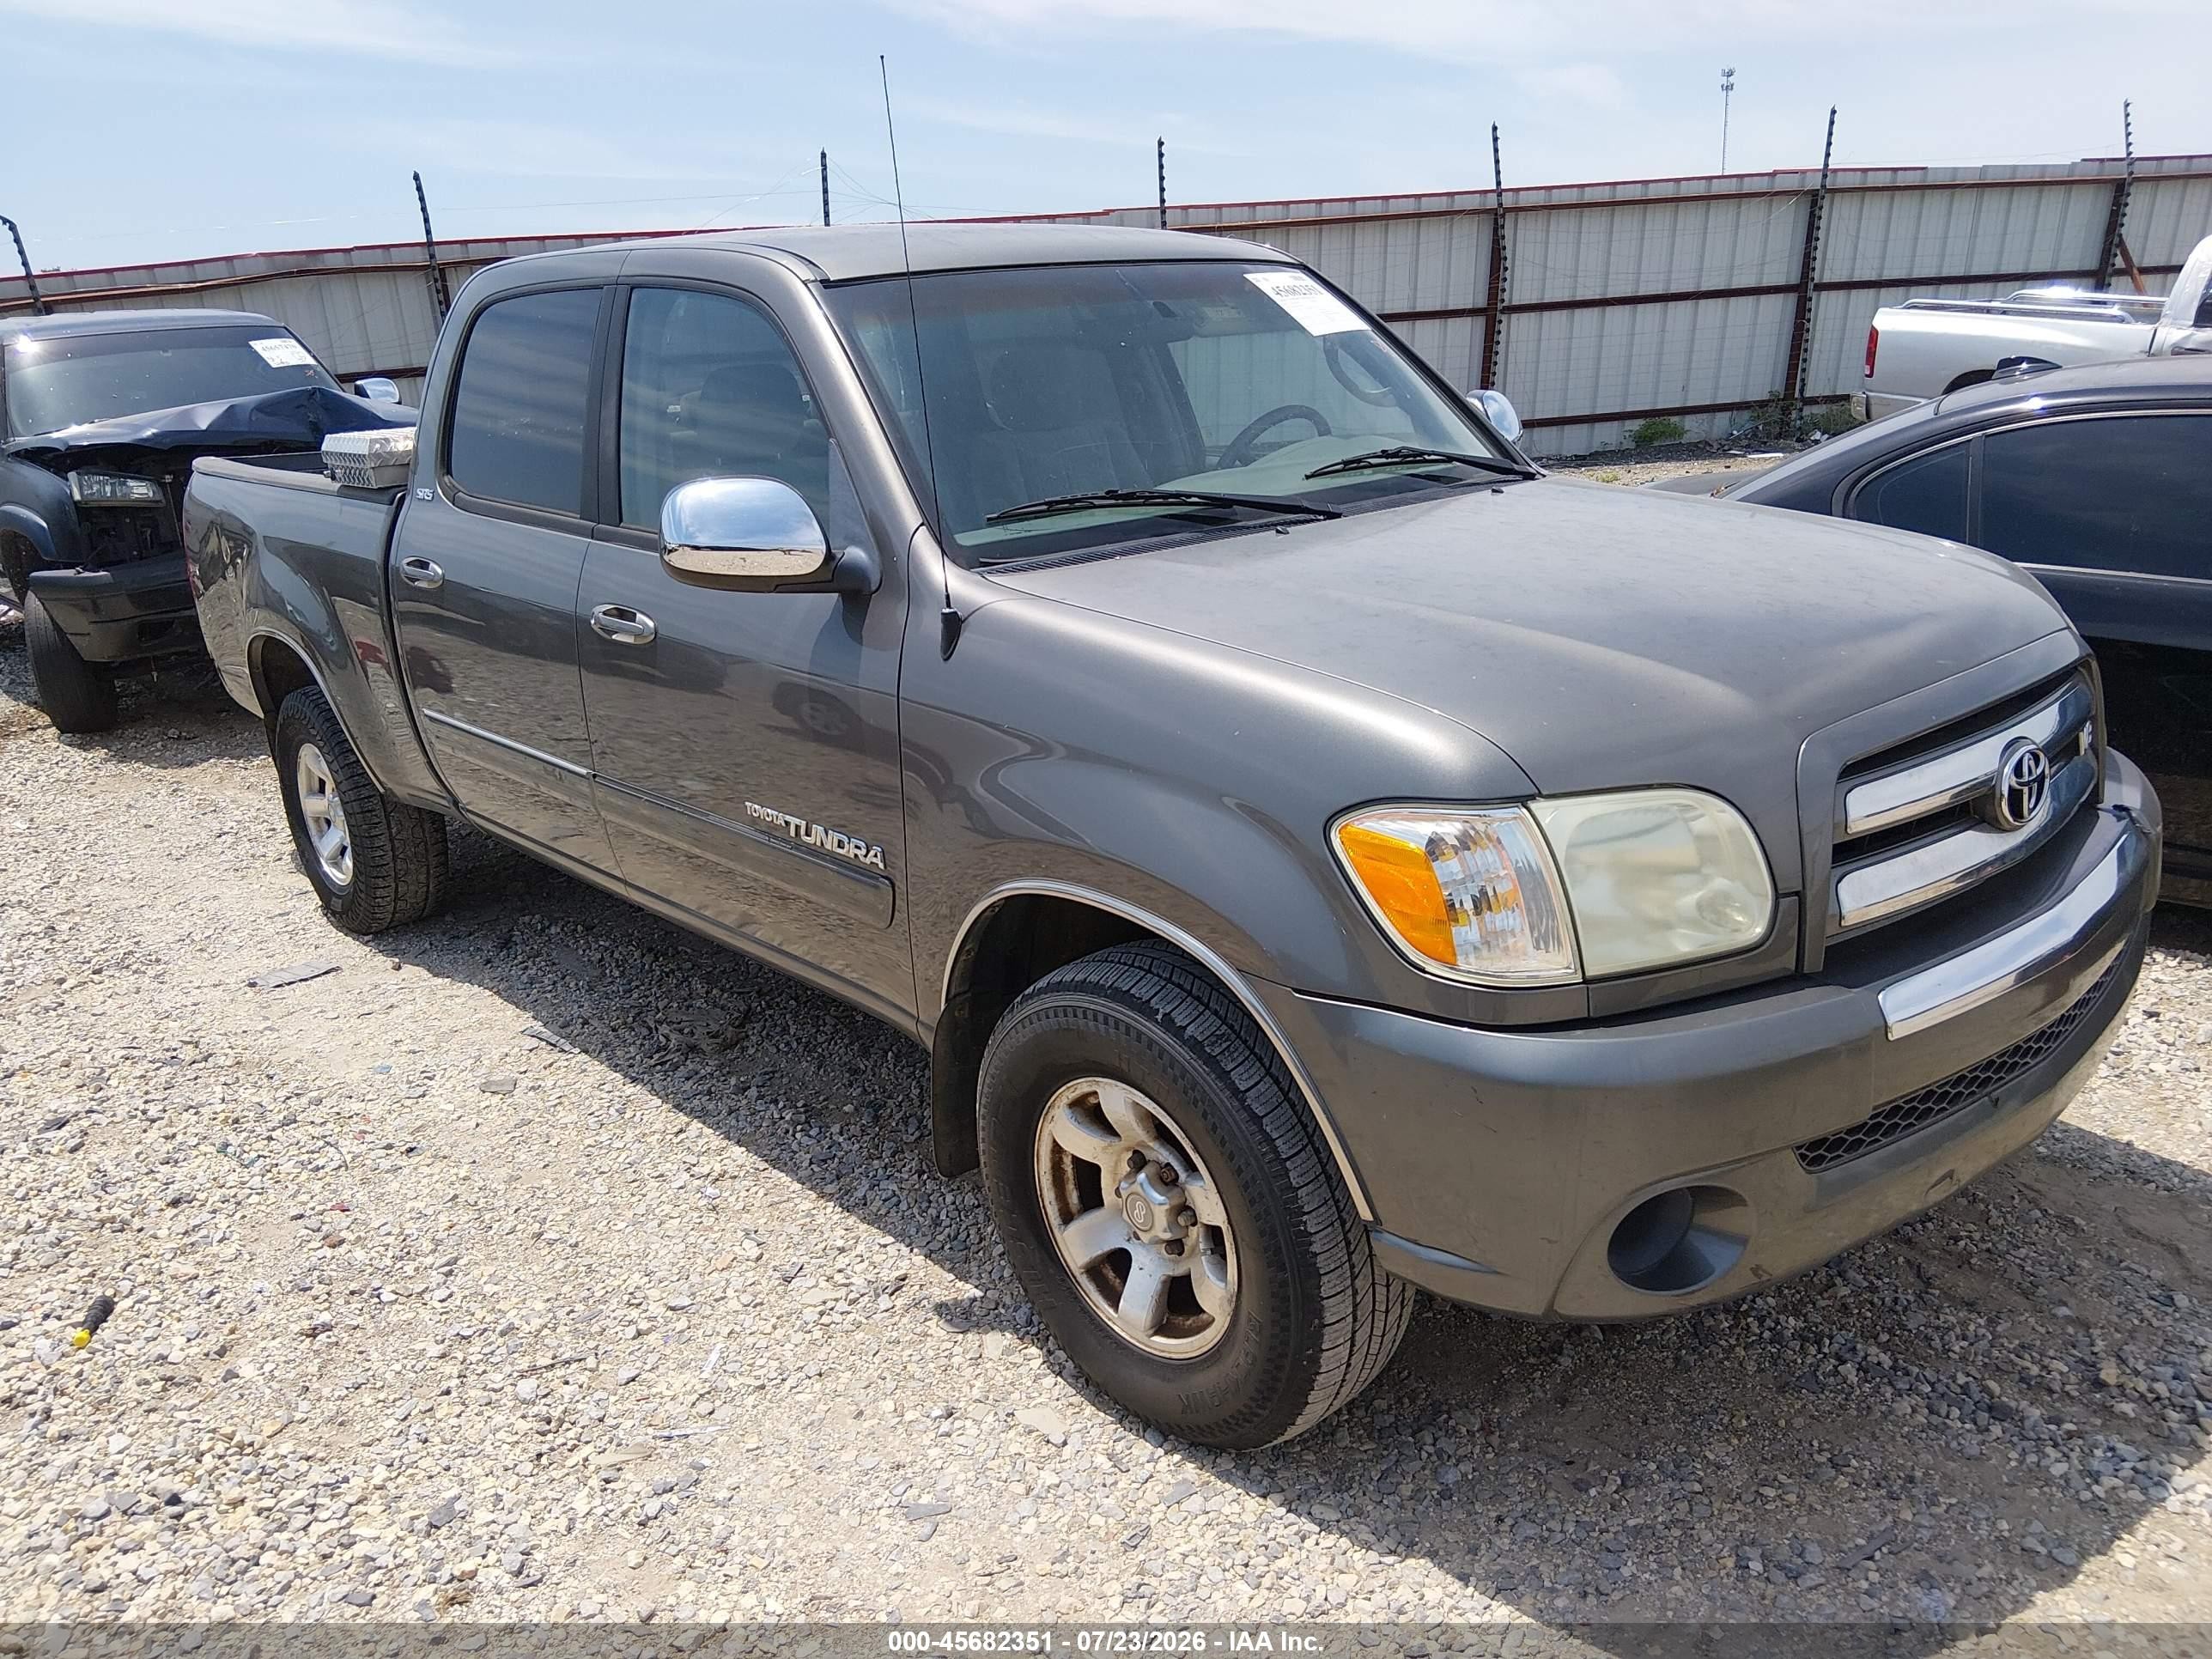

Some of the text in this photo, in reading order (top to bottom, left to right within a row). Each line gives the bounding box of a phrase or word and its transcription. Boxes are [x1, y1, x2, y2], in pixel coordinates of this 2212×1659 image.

[1271, 284, 1324, 298] 45682351
[744, 801, 886, 870] TOYOTA TUNDRA
